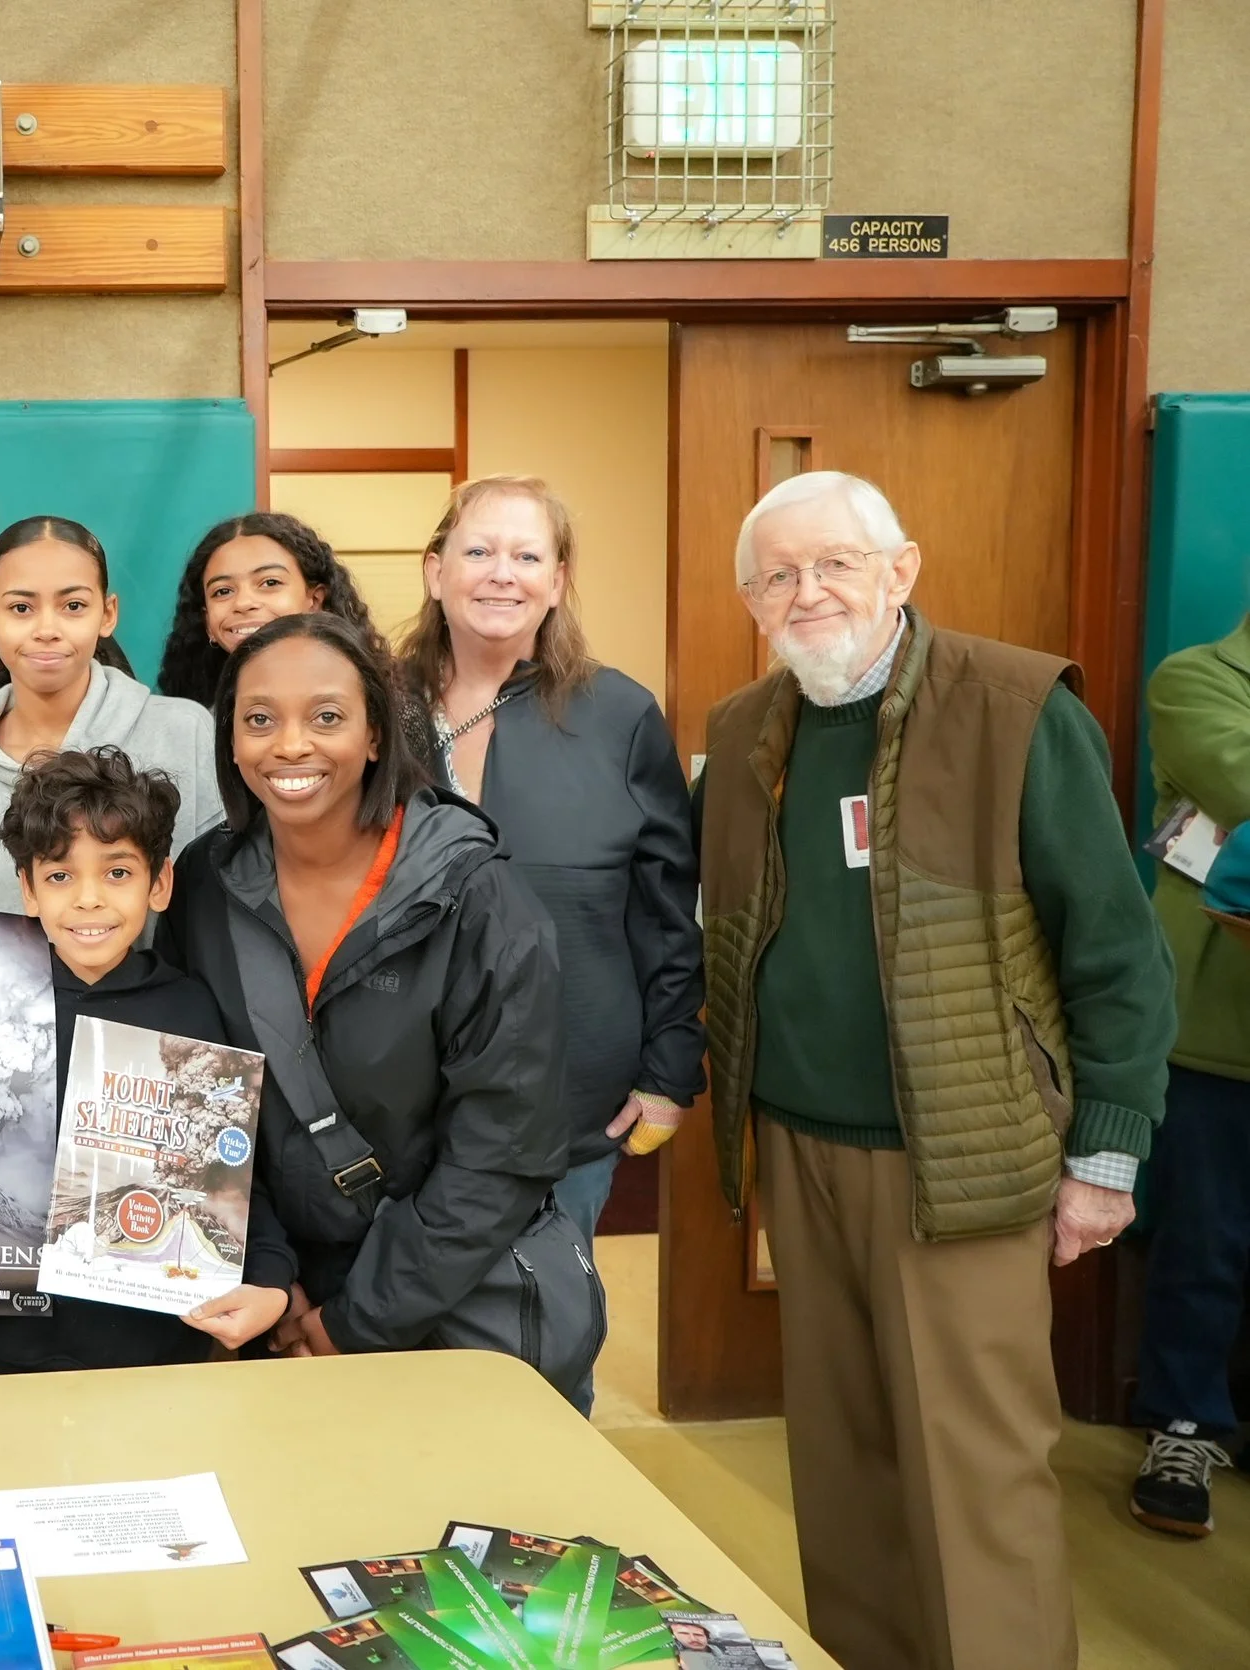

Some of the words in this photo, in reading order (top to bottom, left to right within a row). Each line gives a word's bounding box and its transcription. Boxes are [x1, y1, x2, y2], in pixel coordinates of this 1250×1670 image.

[850, 221, 924, 236] CAPACITY
[829, 238, 860, 252] 456
[868, 238, 941, 253] PERSONS
[373, 975, 400, 988] REI
[103, 1070, 175, 1111] MOUNT
[75, 1100, 107, 1132] ST.
[109, 1104, 189, 1150] HELENS
[222, 1133, 247, 1150] Sticker
[76, 1138, 95, 1147] AND
[98, 1141, 116, 1151] THE
[120, 1145, 141, 1156] RING
[143, 1150, 156, 1158] OF
[158, 1153, 179, 1164] FIRE
[224, 1146, 241, 1158] Fun!
[129, 1199, 157, 1213] Volcano
[127, 1209, 156, 1225] Activity
[130, 1221, 150, 1235] Book
[137, 1283, 150, 1291] other
[137, 1291, 147, 1299] and
[444, 1558, 467, 1583] FACILITY?
[587, 1554, 600, 1577] FACILITY?
[462, 1580, 491, 1613] PRODUCTION
[581, 1575, 595, 1605] PRODUCTION
[398, 1611, 433, 1638] FACILITY?
[83, 1654, 102, 1663] What
[102, 1652, 134, 1662] Everyone
[134, 1649, 159, 1657] Should
[158, 1647, 178, 1655] Know
[178, 1645, 201, 1653] Before
[201, 1643, 230, 1652] Disaster
[230, 1639, 257, 1649] Strikes!
